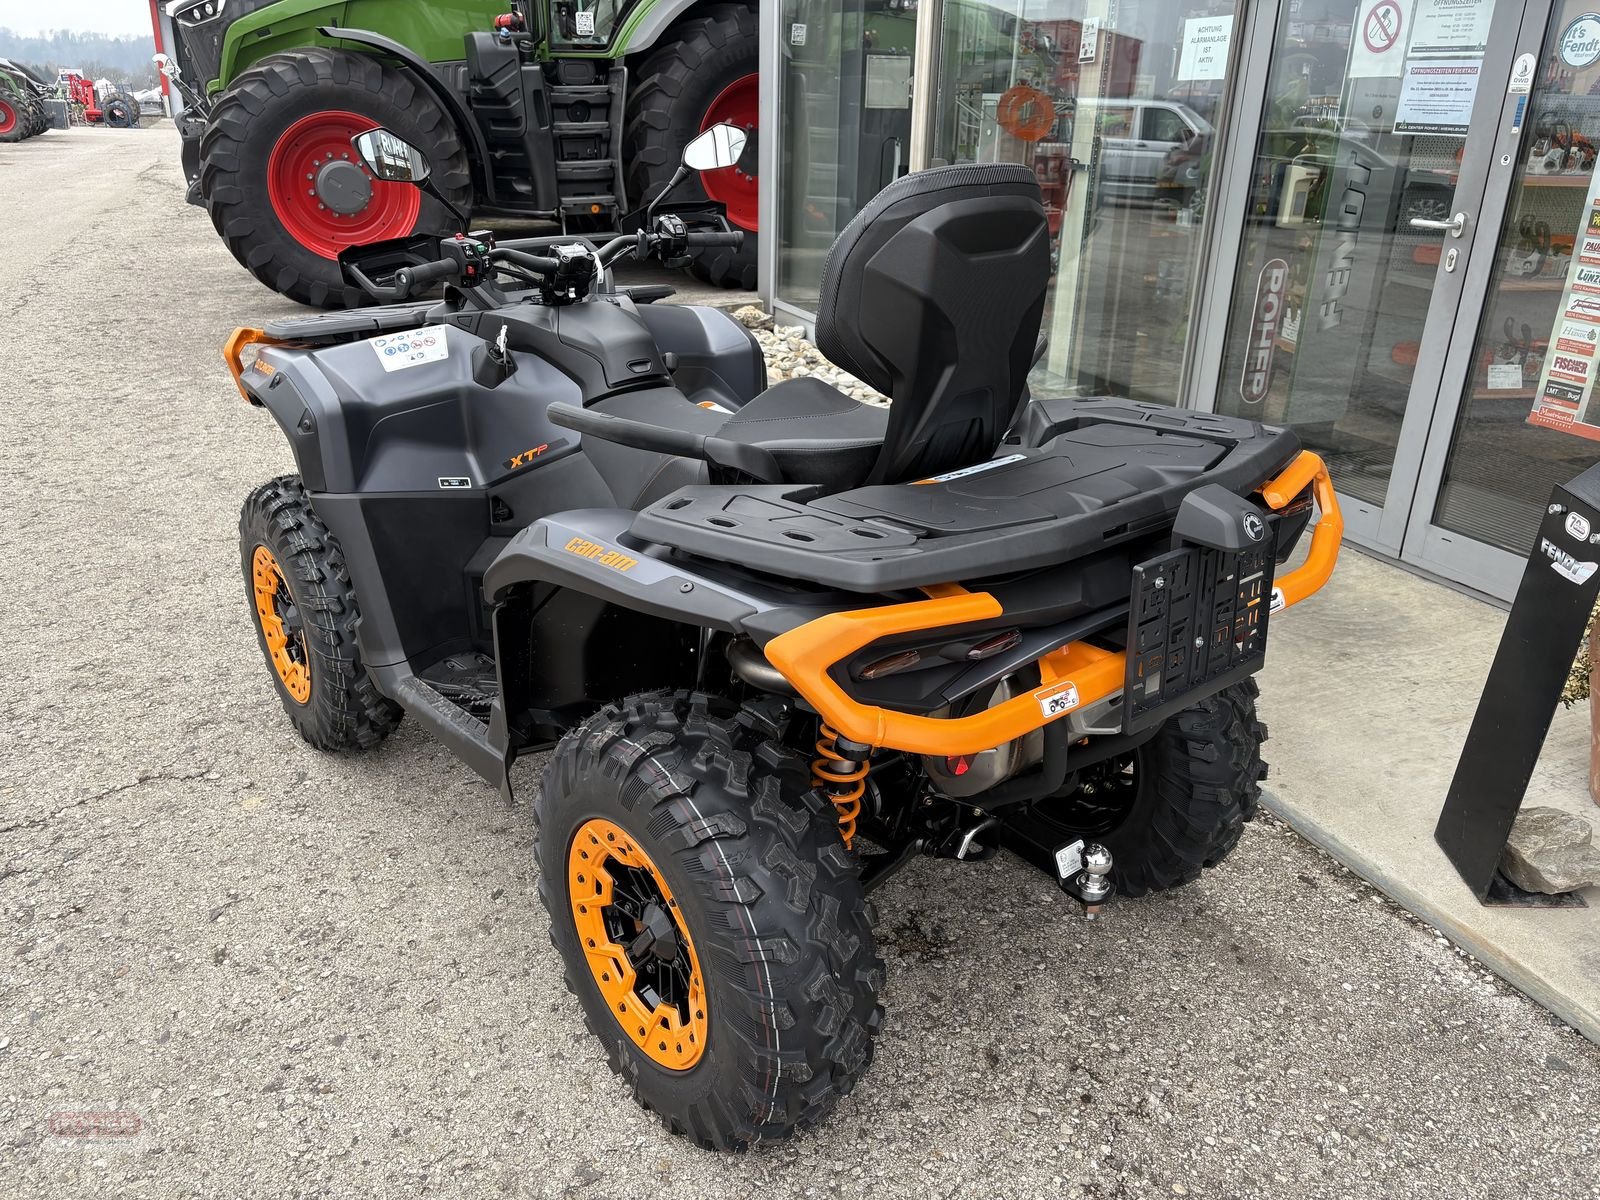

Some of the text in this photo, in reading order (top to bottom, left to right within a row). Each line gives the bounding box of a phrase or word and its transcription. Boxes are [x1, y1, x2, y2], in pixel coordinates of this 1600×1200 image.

[1198, 25, 1222, 33] ACHTUNG
[1190, 35, 1228, 44] ALARMANLAGE
[1316, 150, 1371, 333] FENDT
[1554, 356, 1588, 375] FISCHER
[1546, 386, 1559, 395] LMT
[564, 536, 638, 572] can-am
